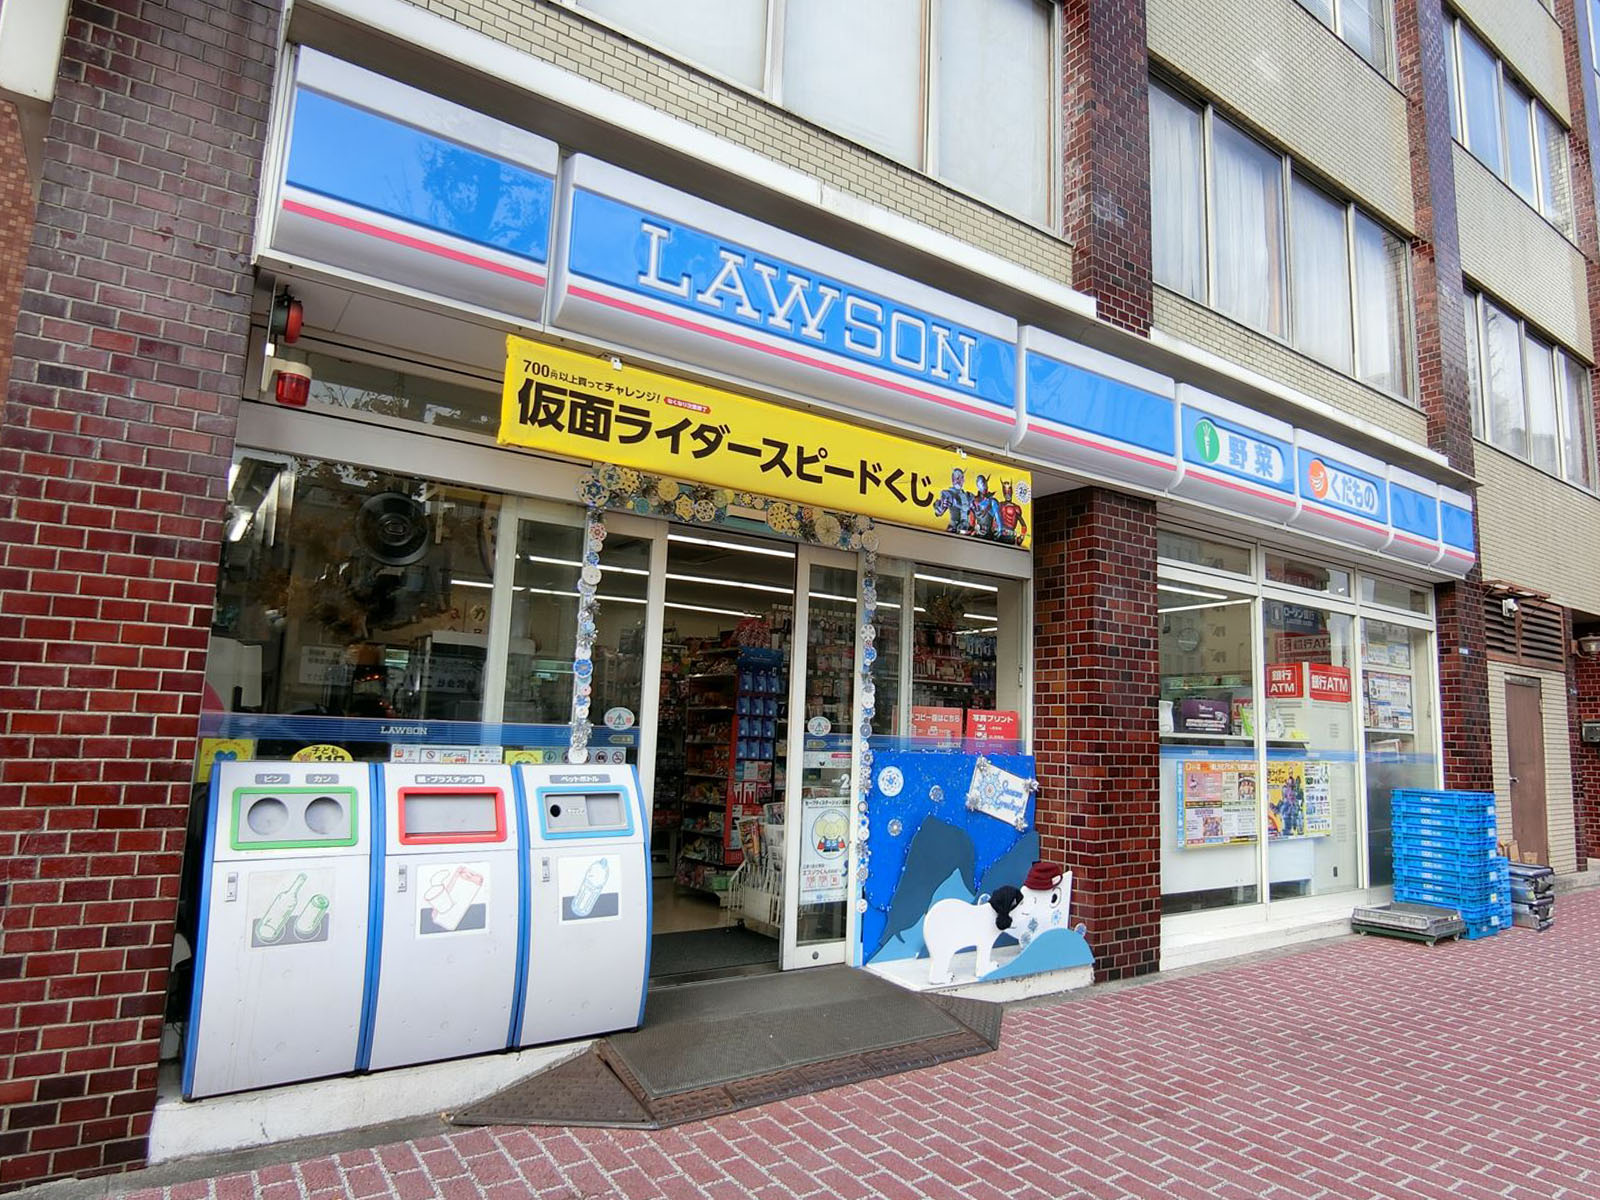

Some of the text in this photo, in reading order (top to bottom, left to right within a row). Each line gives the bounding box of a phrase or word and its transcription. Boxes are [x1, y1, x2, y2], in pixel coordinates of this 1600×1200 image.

[638, 222, 977, 388] LAWSON
[517, 378, 935, 508] 仮面ライダースピードくじ
[1227, 434, 1274, 479] 野菜
[1329, 472, 1375, 511] くだもの
[1270, 682, 1295, 693] ATM
[380, 726, 428, 735] LAWSON
[311, 746, 339, 756] 子ども
[263, 775, 283, 783] ビン
[313, 775, 332, 783] カン
[559, 775, 600, 783] ペットボトル
